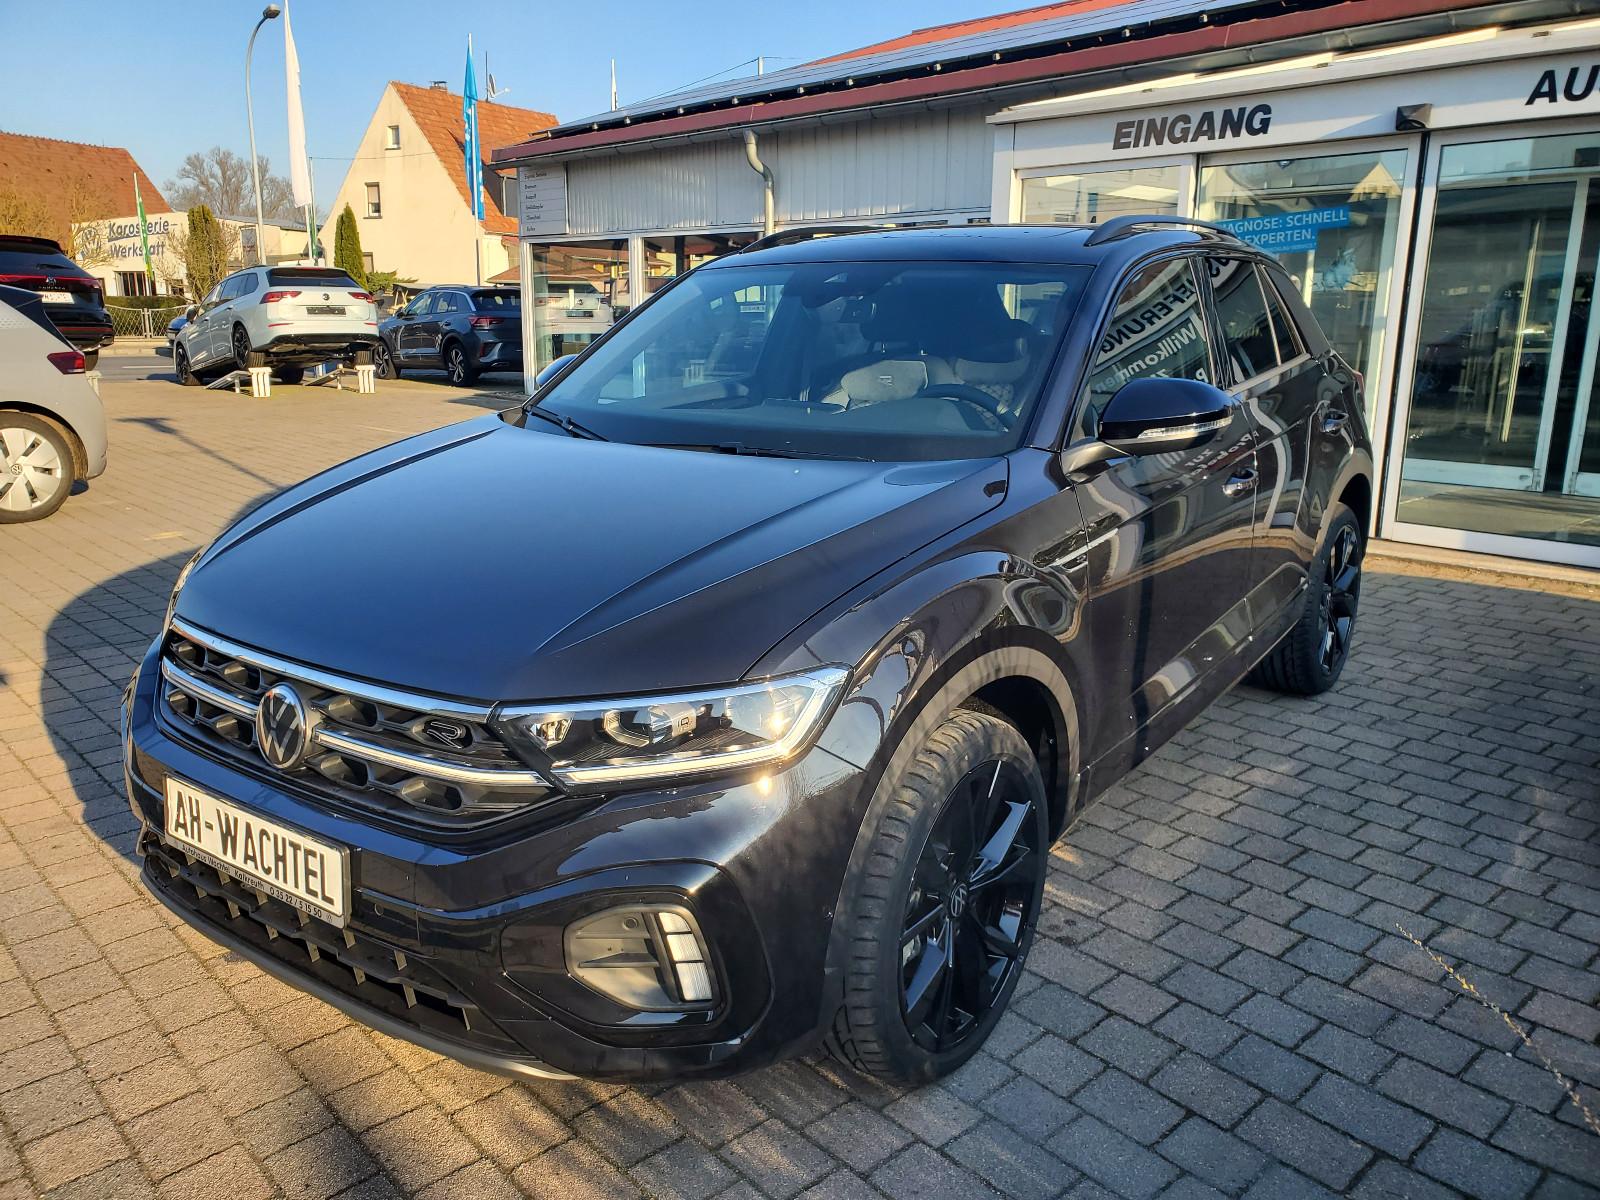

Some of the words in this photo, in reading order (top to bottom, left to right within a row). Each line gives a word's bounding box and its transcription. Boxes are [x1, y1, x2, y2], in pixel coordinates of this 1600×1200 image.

[1525, 64, 1600, 106] AU
[1113, 103, 1272, 150] EINGANG
[1286, 208, 1347, 228] SCHNELL
[110, 241, 166, 258] Werksatt
[174, 790, 336, 906] AH-WACHTEL
[182, 844, 207, 862] Autohaus
[207, 856, 231, 874] Wachtel
[234, 869, 265, 890] Kalkreuth
